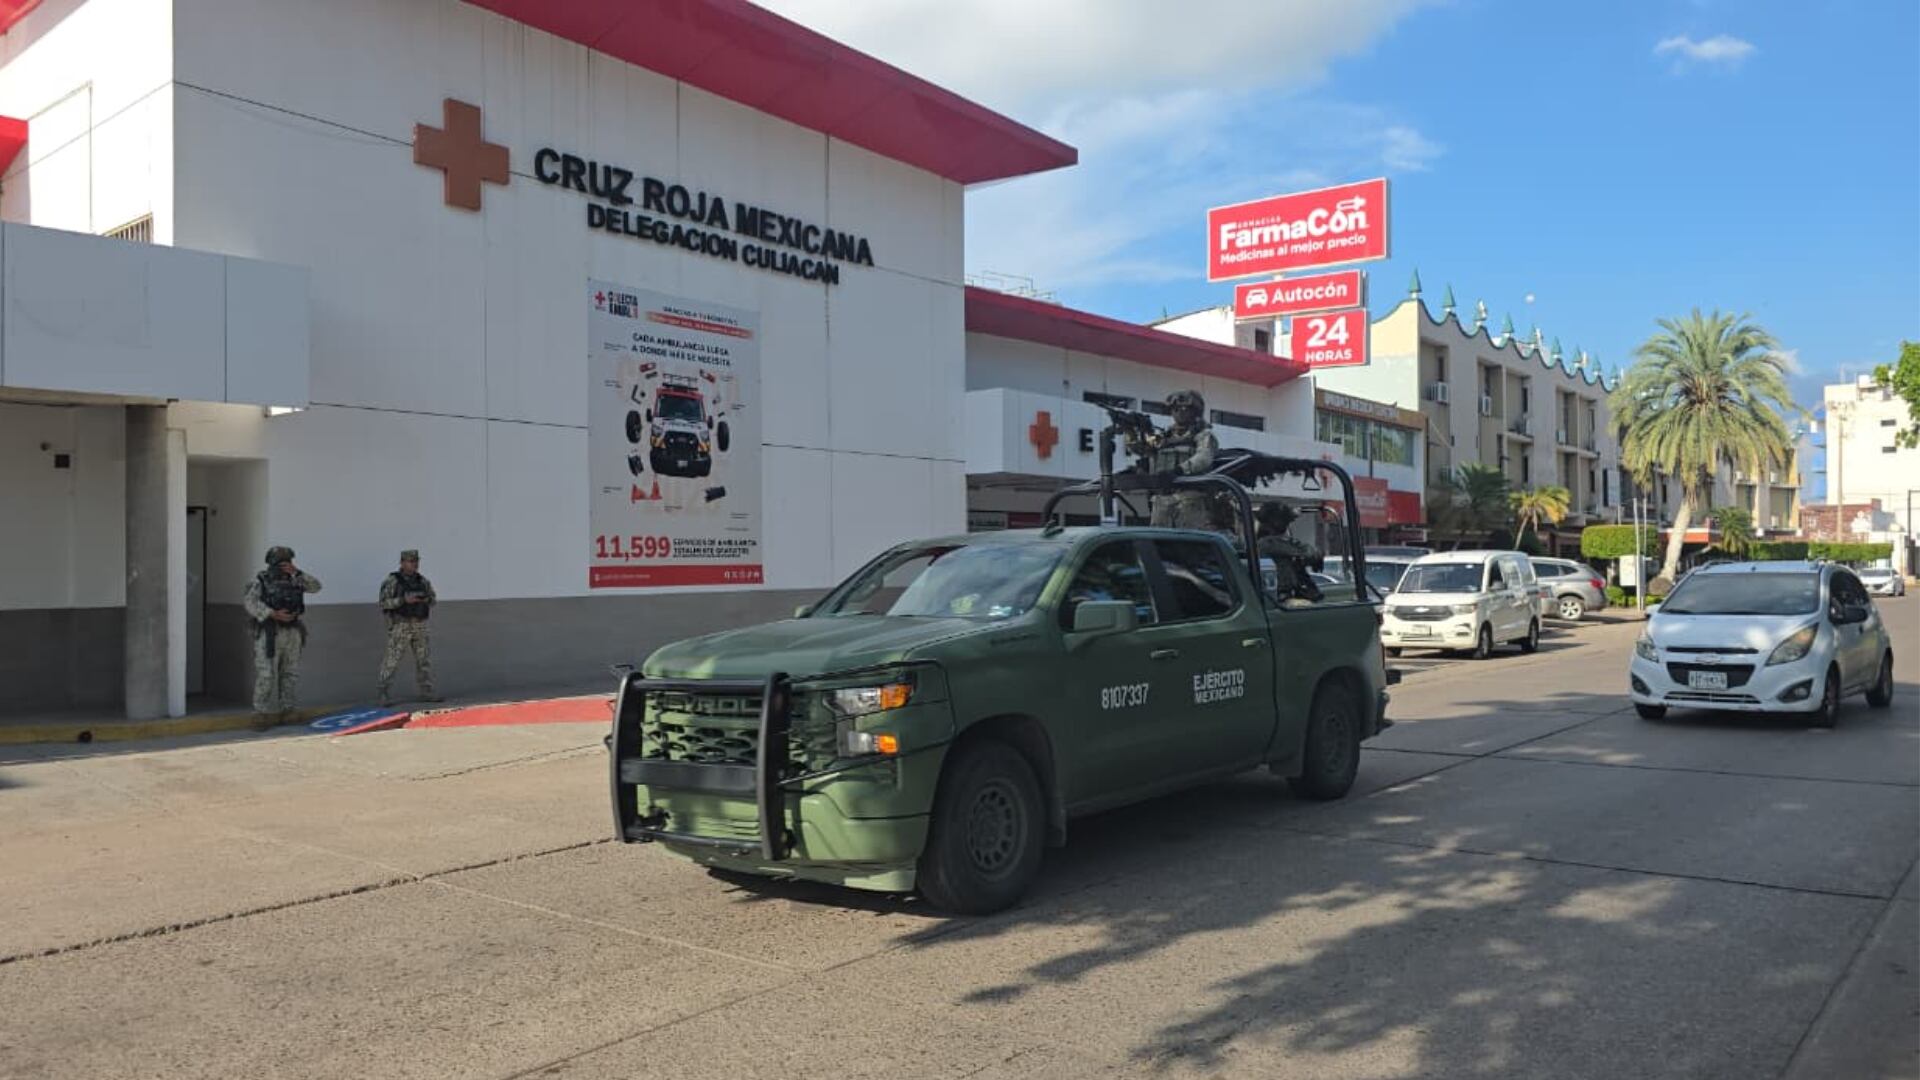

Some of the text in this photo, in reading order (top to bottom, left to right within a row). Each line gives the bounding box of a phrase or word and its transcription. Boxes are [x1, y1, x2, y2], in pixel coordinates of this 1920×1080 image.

[534, 147, 875, 267] CRUZ ROJA MEXICANA
[587, 203, 738, 262] DELEGACION
[1220, 234, 1367, 265] Medicinas al mejor precio
[1272, 282, 1348, 304] Autocón
[1306, 316, 1349, 348] 24
[1305, 348, 1353, 363] HORAS
[595, 535, 671, 561] 11,599
[1193, 669, 1245, 692] EJÉRCITO
[1101, 683, 1149, 709] 8107337
[1195, 686, 1244, 704] MEXICANO
